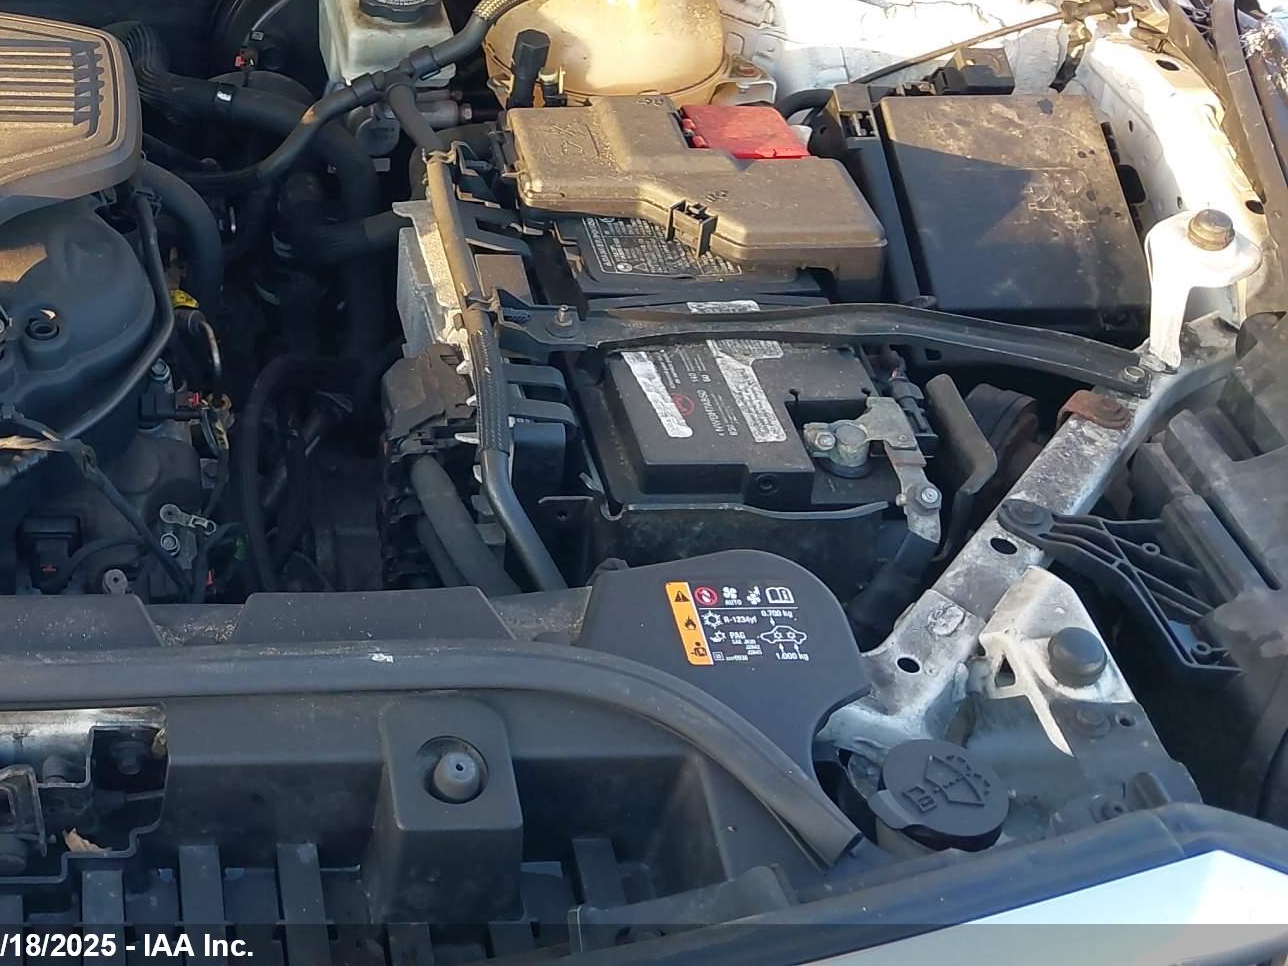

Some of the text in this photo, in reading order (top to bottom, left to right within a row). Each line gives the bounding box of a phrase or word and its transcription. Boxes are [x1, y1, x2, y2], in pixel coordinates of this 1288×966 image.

[782, 610, 794, 618] kg
[723, 615, 757, 625] R-1234yf
[729, 631, 746, 639] PAG
[776, 652, 810, 661] 1.000 kg
